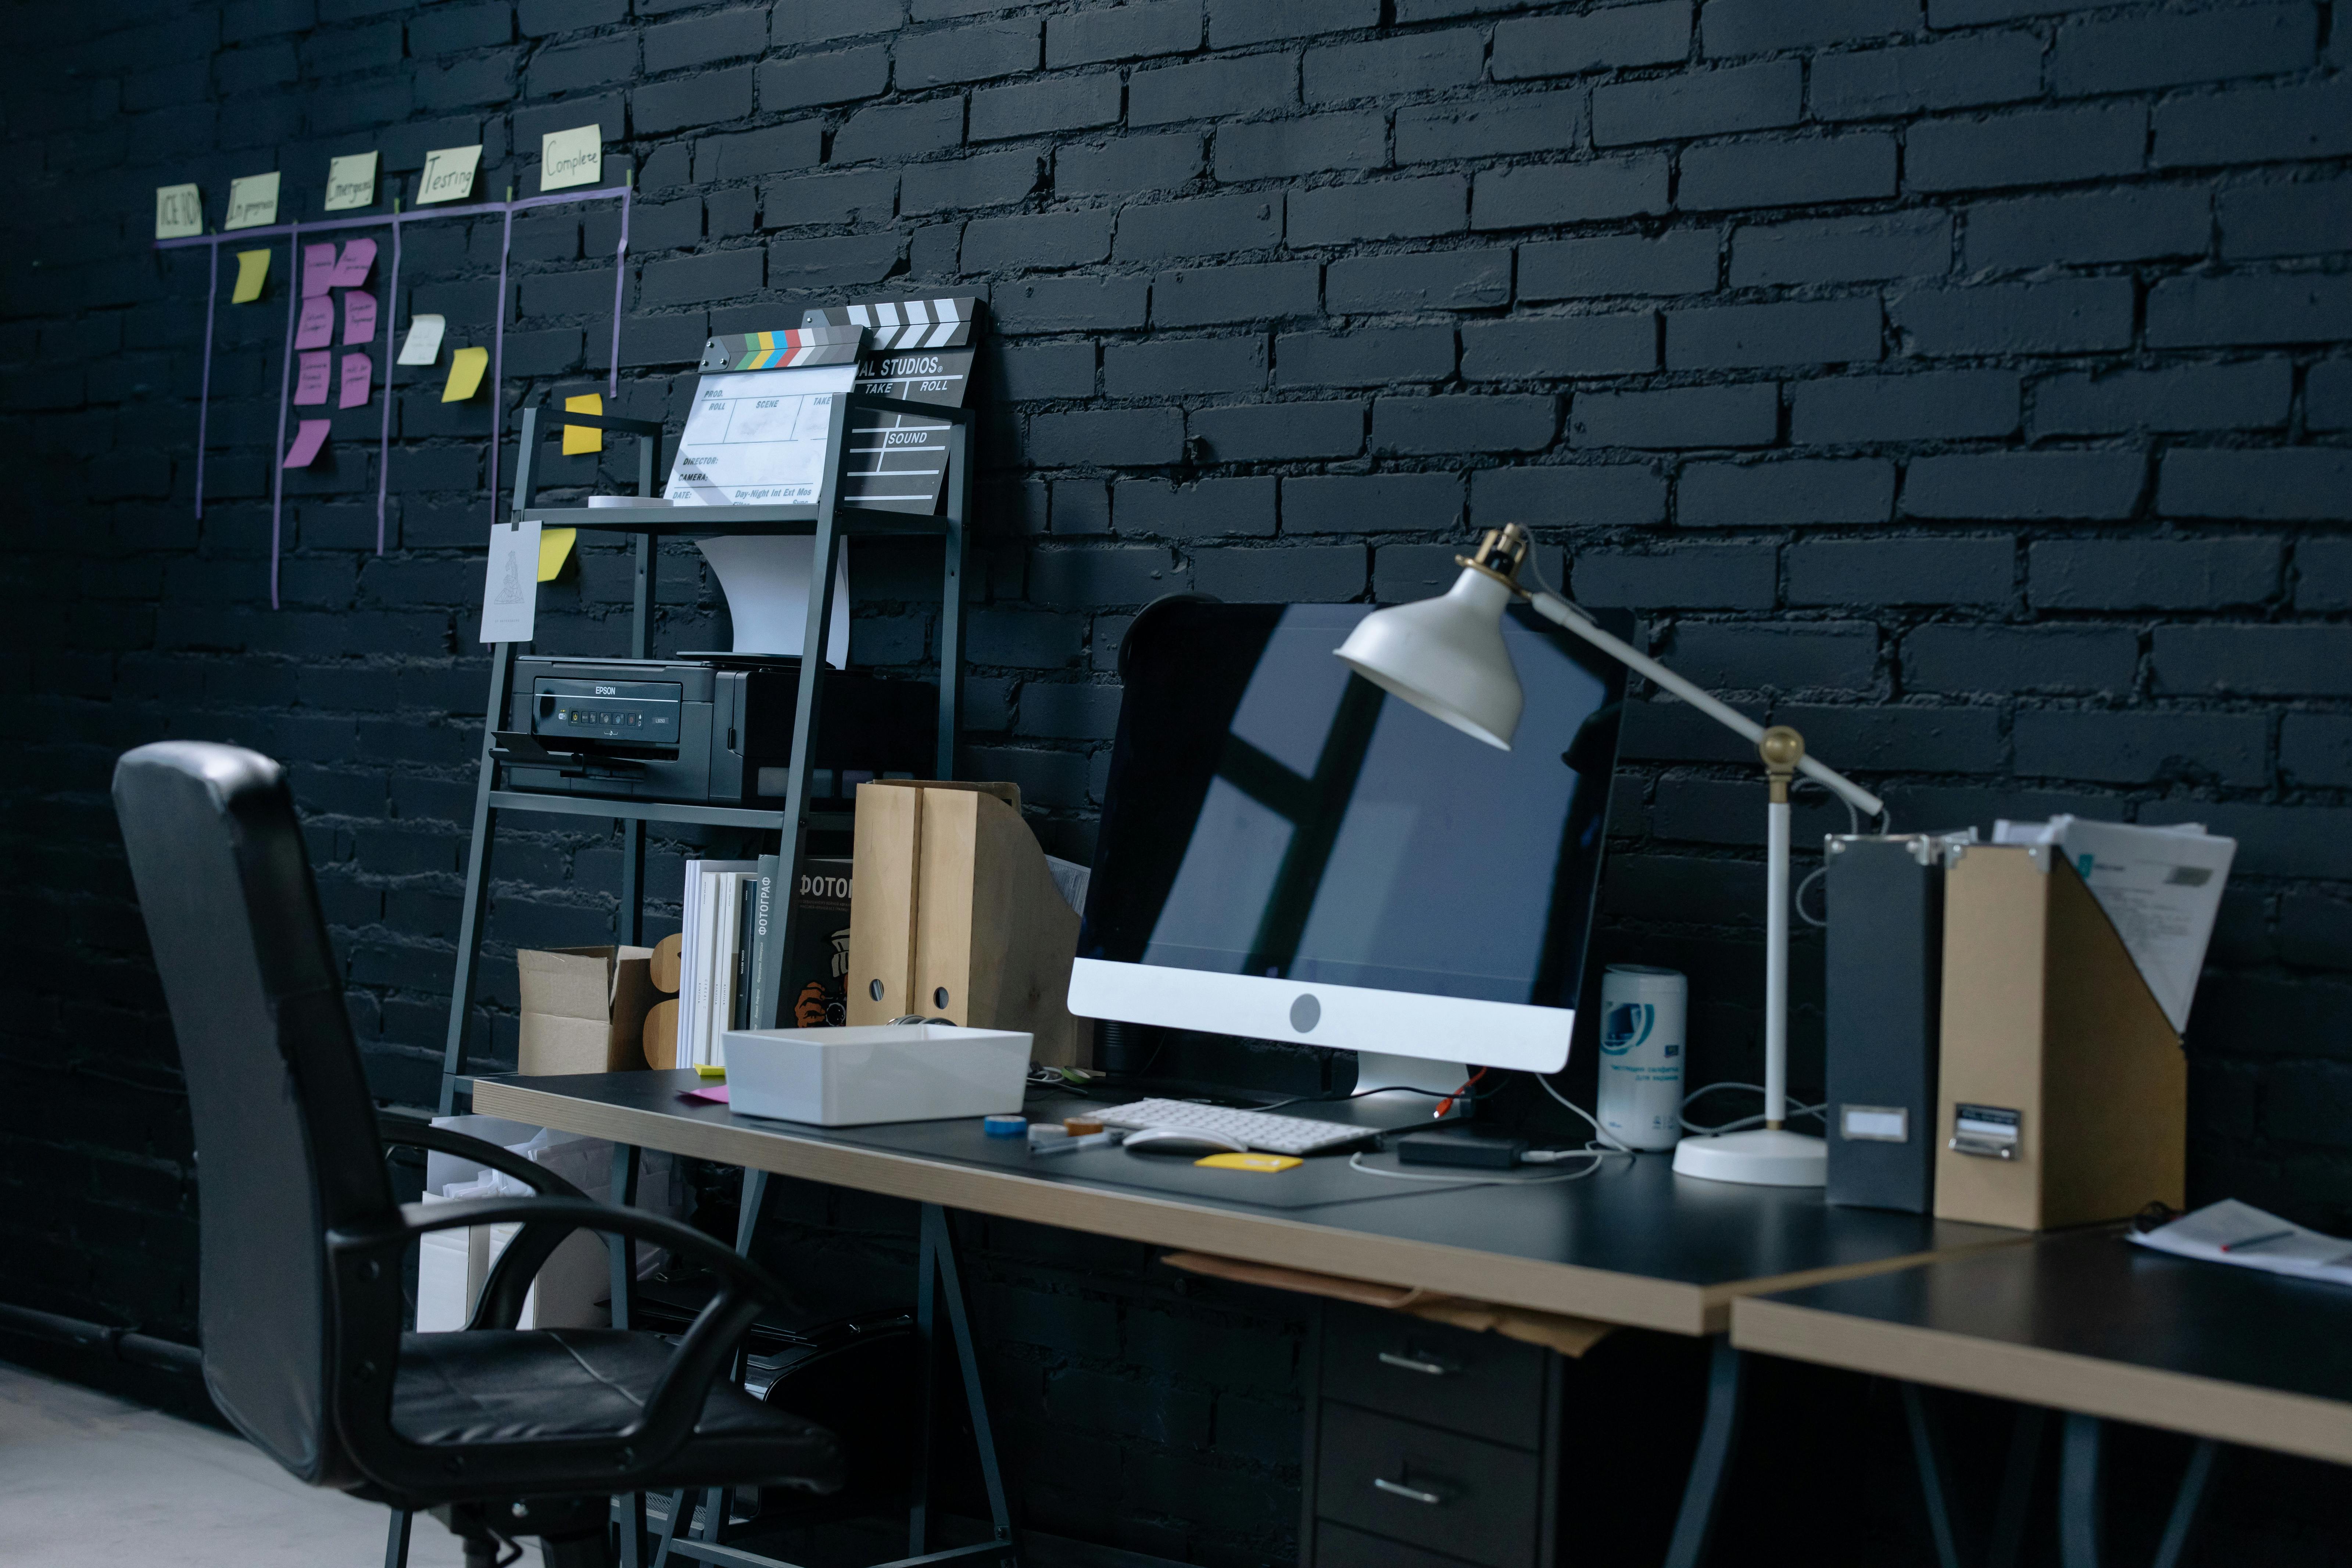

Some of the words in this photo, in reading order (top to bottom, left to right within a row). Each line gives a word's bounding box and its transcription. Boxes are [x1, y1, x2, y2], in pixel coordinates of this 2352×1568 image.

[546, 140, 598, 176] Complete
[425, 155, 473, 194] Testing
[856, 359, 875, 377] AL
[704, 390, 723, 398] PROD.
[865, 383, 893, 394] TAKE
[920, 380, 948, 391] ROLL
[709, 402, 726, 411] ROLL
[756, 400, 779, 408] SCENE
[813, 397, 832, 405] TAKE
[888, 432, 927, 444] SOUND
[683, 457, 718, 465] DIRECTOR:
[672, 491, 692, 499] DATE:
[771, 488, 782, 497] Int
[783, 488, 795, 497] Ext
[797, 488, 812, 496] Mos
[595, 686, 616, 695] EPSON
[759, 877, 771, 935] ФОТОГРАФ
